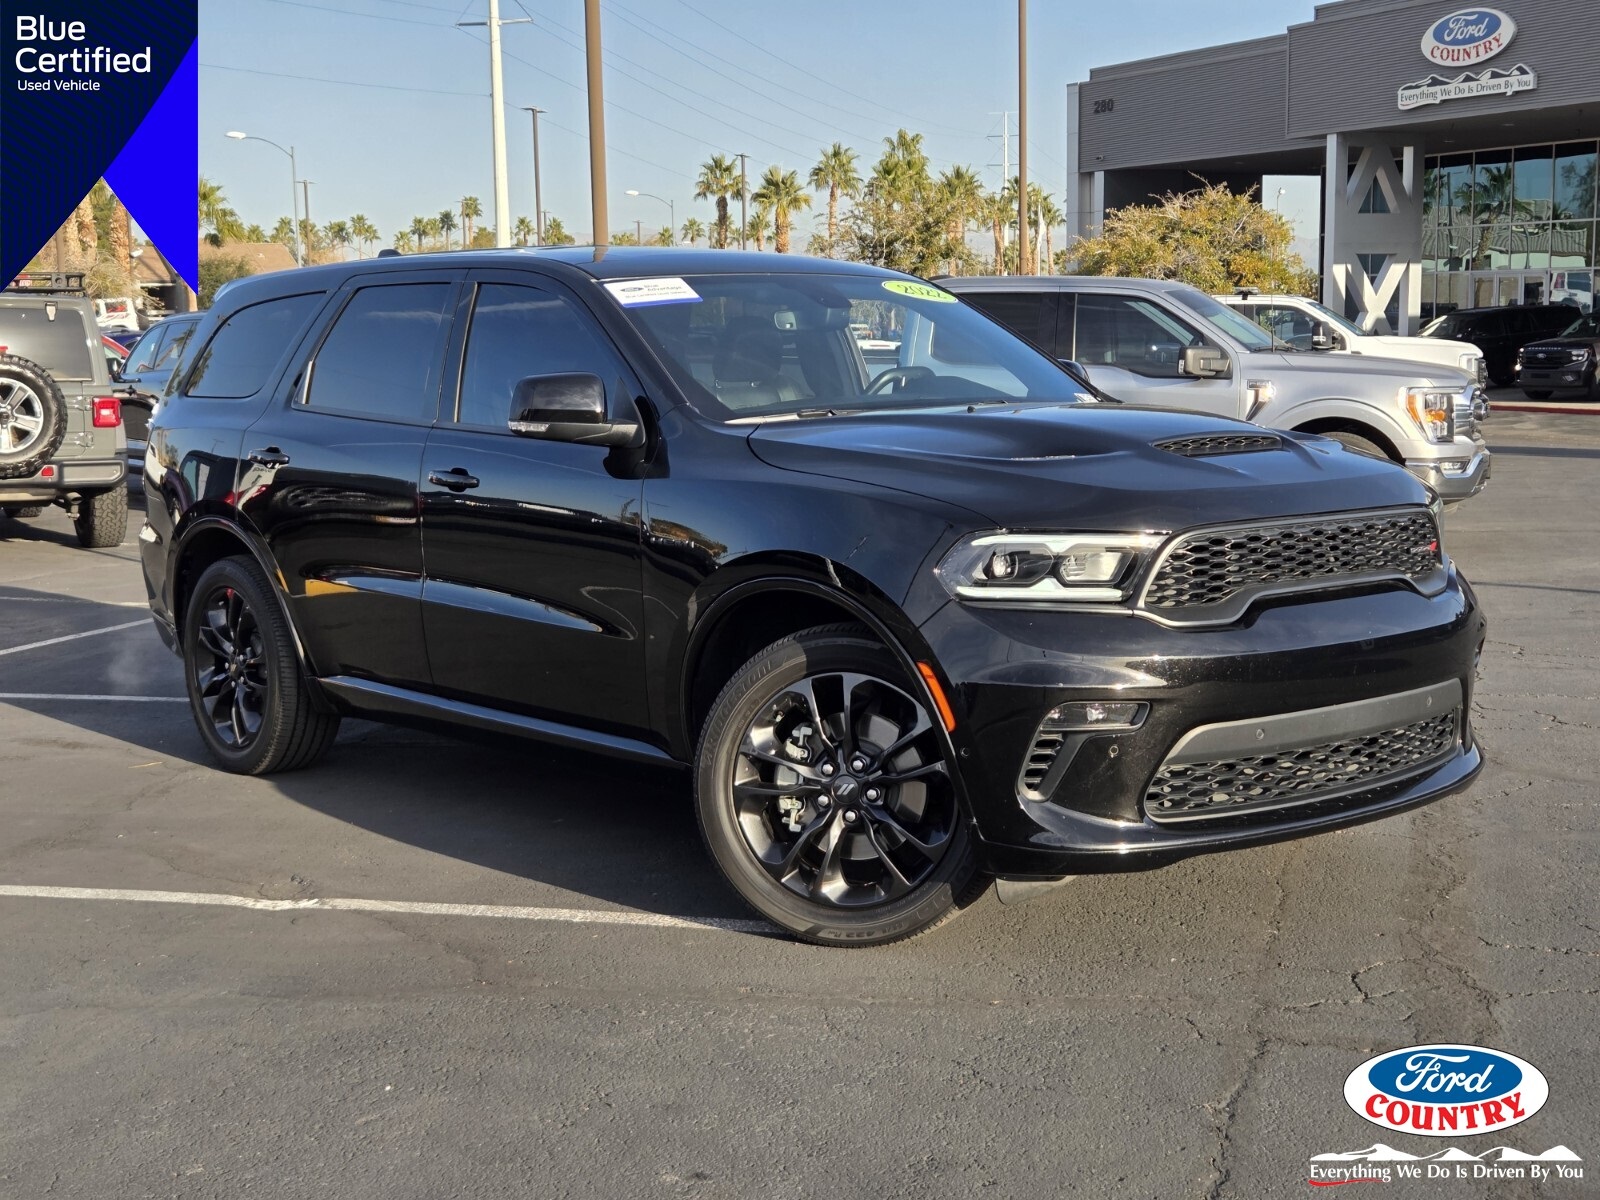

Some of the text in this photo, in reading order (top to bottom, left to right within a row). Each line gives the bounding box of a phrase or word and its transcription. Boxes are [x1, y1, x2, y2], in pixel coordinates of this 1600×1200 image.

[1444, 13, 1489, 41] Ford
[1430, 33, 1503, 62] COUNTRY
[1400, 77, 1531, 102] Everything We Do Is Driven By You
[896, 284, 948, 299] 2022
